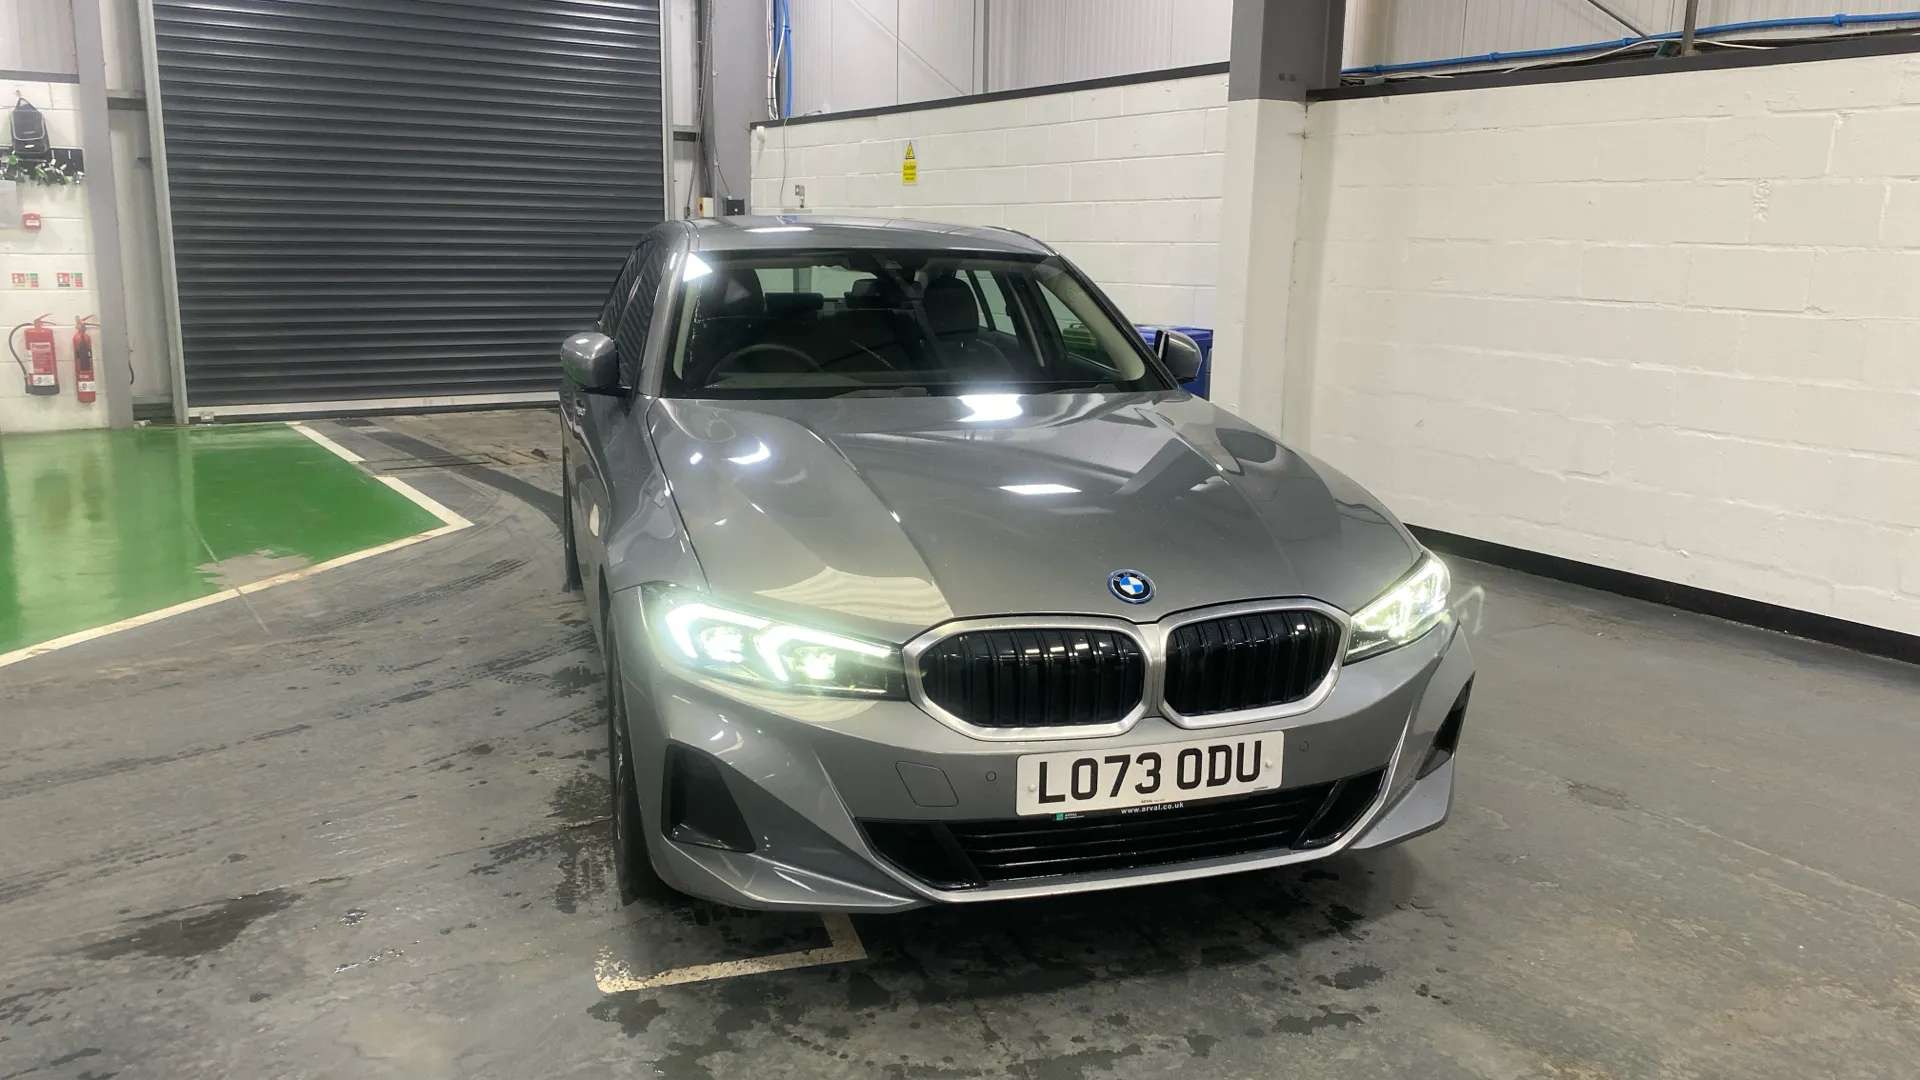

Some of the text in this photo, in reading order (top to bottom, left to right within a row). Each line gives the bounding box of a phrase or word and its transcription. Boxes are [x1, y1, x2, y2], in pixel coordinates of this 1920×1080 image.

[1038, 740, 1263, 804] LO73 ODU
[1120, 802, 1184, 814] www.arval.co.uk
